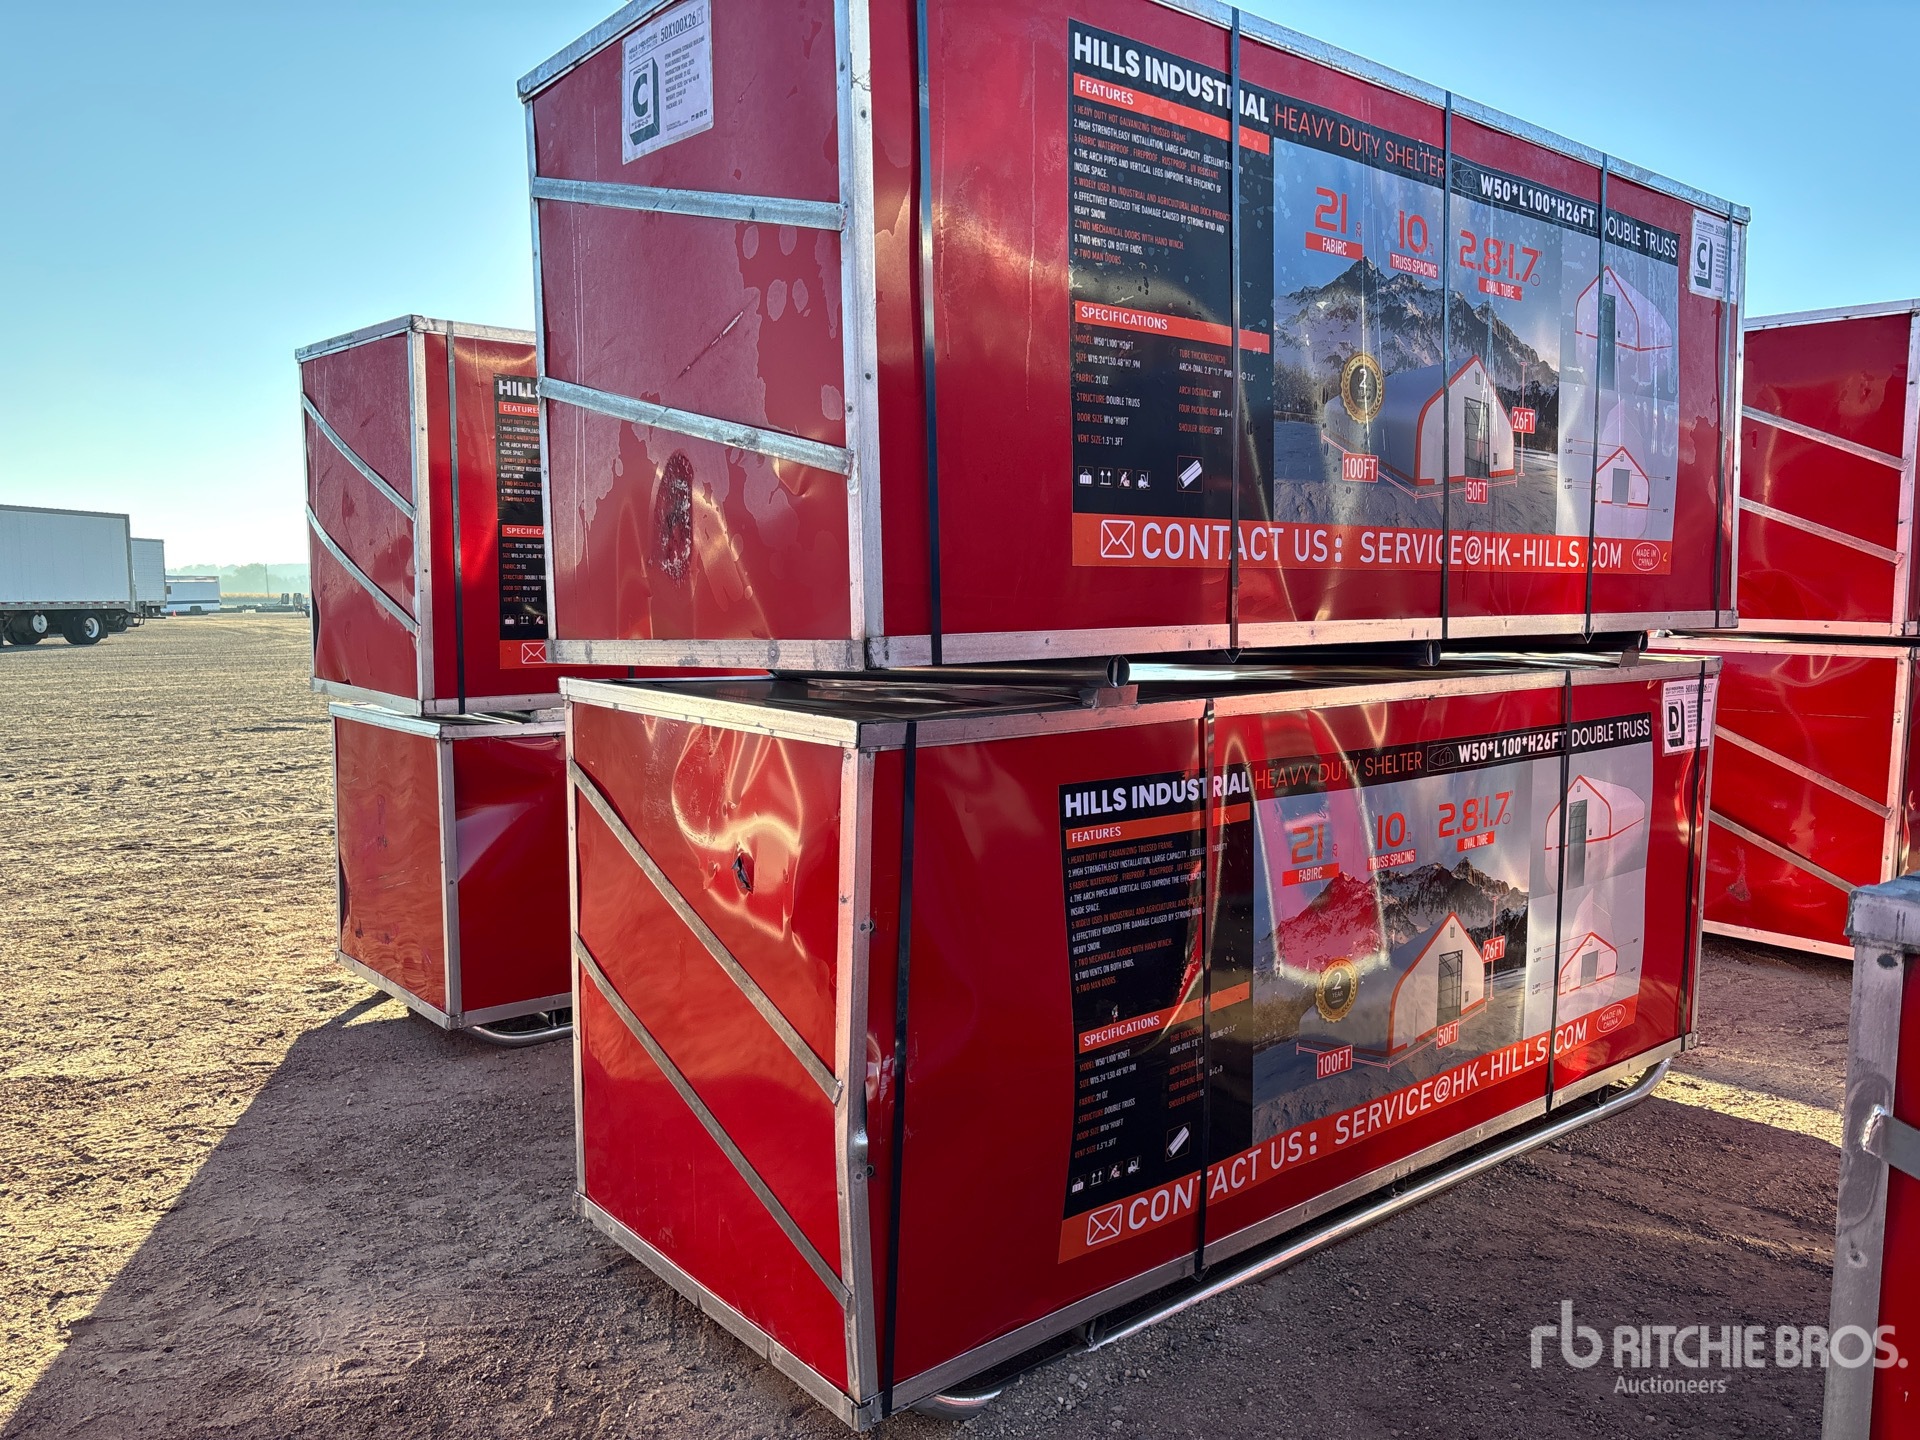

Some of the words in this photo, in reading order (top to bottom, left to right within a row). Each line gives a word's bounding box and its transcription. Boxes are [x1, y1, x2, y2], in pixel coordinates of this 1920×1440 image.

[633, 73, 648, 117] C
[1080, 80, 1134, 105] FEATURES
[1094, 109, 1107, 121] DUTY
[1108, 113, 1117, 124] HOT
[1075, 32, 1140, 78] HILLS
[1275, 104, 1334, 142] HEAVY
[1340, 124, 1380, 157] DUTY
[1386, 141, 1444, 178] SHELTER
[1644, 230, 1676, 258] TRUSS
[1165, 143, 1178, 154] LARGE
[1180, 147, 1200, 160] CAPACITY
[1204, 154, 1224, 167] EXCELLENT
[1074, 162, 1090, 173] INSIDE
[1091, 166, 1108, 178] SPACE.
[1089, 152, 1102, 162] ARCH
[1104, 155, 1117, 166] PIPES
[1118, 159, 1128, 169] AND
[1130, 161, 1151, 174] VERTICAL
[1153, 167, 1163, 177] LEGS
[1164, 170, 1183, 183] IMPROVE
[1194, 177, 1215, 192] EFFICIENCY
[1216, 184, 1221, 193] OF
[1098, 182, 1110, 192] USED
[1111, 185, 1116, 194] IN
[1118, 187, 1145, 200] INDUSTRIAL
[1147, 193, 1156, 203] AND
[1074, 205, 1089, 216] HEAVY
[1091, 208, 1106, 220] SNOW.
[1109, 198, 1130, 210] REDUCED
[1132, 203, 1140, 213] THE
[1142, 206, 1161, 217] DAMAGE
[1162, 210, 1179, 221] CAUSED
[1181, 215, 1186, 223] BY
[1187, 217, 1204, 228] STRONG
[1205, 221, 1215, 231] WIND
[1216, 224, 1224, 233] AND
[1315, 187, 1347, 234] 21
[1092, 223, 1123, 237] MECHANICAL
[1124, 230, 1140, 240] DOORS
[1142, 234, 1154, 242] WITH
[1399, 210, 1428, 253] 10
[1092, 237, 1106, 248] VENTS
[1108, 240, 1114, 249] ON
[1116, 241, 1128, 252] BOTH
[1130, 245, 1143, 255] ENDS.
[1322, 237, 1347, 256] FABIRC
[1697, 243, 1706, 270] C
[1392, 254, 1411, 272] TRUSS
[1412, 259, 1437, 279] SPACING
[1486, 279, 1500, 295] OVAL
[1501, 283, 1514, 299] TUBE
[1081, 306, 1168, 330] SPECIFICATIONS
[499, 380, 538, 398] HILL
[1514, 410, 1534, 431] 26FT
[1345, 457, 1377, 478] 100FT
[1468, 481, 1487, 501] 50FT
[1142, 522, 1284, 561] CONTACT
[1636, 549, 1650, 557] MADE
[1668, 706, 1679, 732] D
[1065, 787, 1126, 817] HILLS
[1132, 772, 1250, 809] INDUSTRIAL
[1255, 764, 1314, 791] HEAVY
[1318, 759, 1360, 782] DUTY
[1365, 751, 1422, 777] SHELTER
[1572, 725, 1614, 747] DOUBLE
[1617, 718, 1650, 739] TRUSS
[1072, 826, 1121, 843] FEATURES
[1377, 812, 1406, 850] 10
[1292, 824, 1324, 864] 21
[1152, 854, 1165, 863] LARGE
[1166, 850, 1186, 860] CAPACITY
[1369, 855, 1389, 870] TRUSS
[1390, 850, 1414, 867] SPACING
[1298, 867, 1323, 882] FABIRC
[1083, 892, 1095, 900] ARCH
[1096, 889, 1108, 898] PIPES
[1109, 887, 1118, 895] AND
[1120, 883, 1140, 893] VERTICAL
[1141, 880, 1151, 890] LEGS
[1152, 877, 1171, 888] IMPROVE
[1131, 918, 1150, 929] DAMAGE
[1151, 916, 1167, 924] CAUSED
[1175, 910, 1191, 920] STRONG
[1484, 938, 1504, 961] 26FT
[1332, 972, 1341, 990] 2
[1332, 990, 1344, 998] YEAR
[1601, 1010, 1615, 1021] MADE
[1603, 1018, 1618, 1029] CHINA
[1084, 1015, 1160, 1046] SPECIFICATIONS
[1438, 1022, 1458, 1046] 50FT
[1319, 1048, 1351, 1075] 100FT
[1335, 1019, 1587, 1145] SERVICE@HK-HILLS.COM
